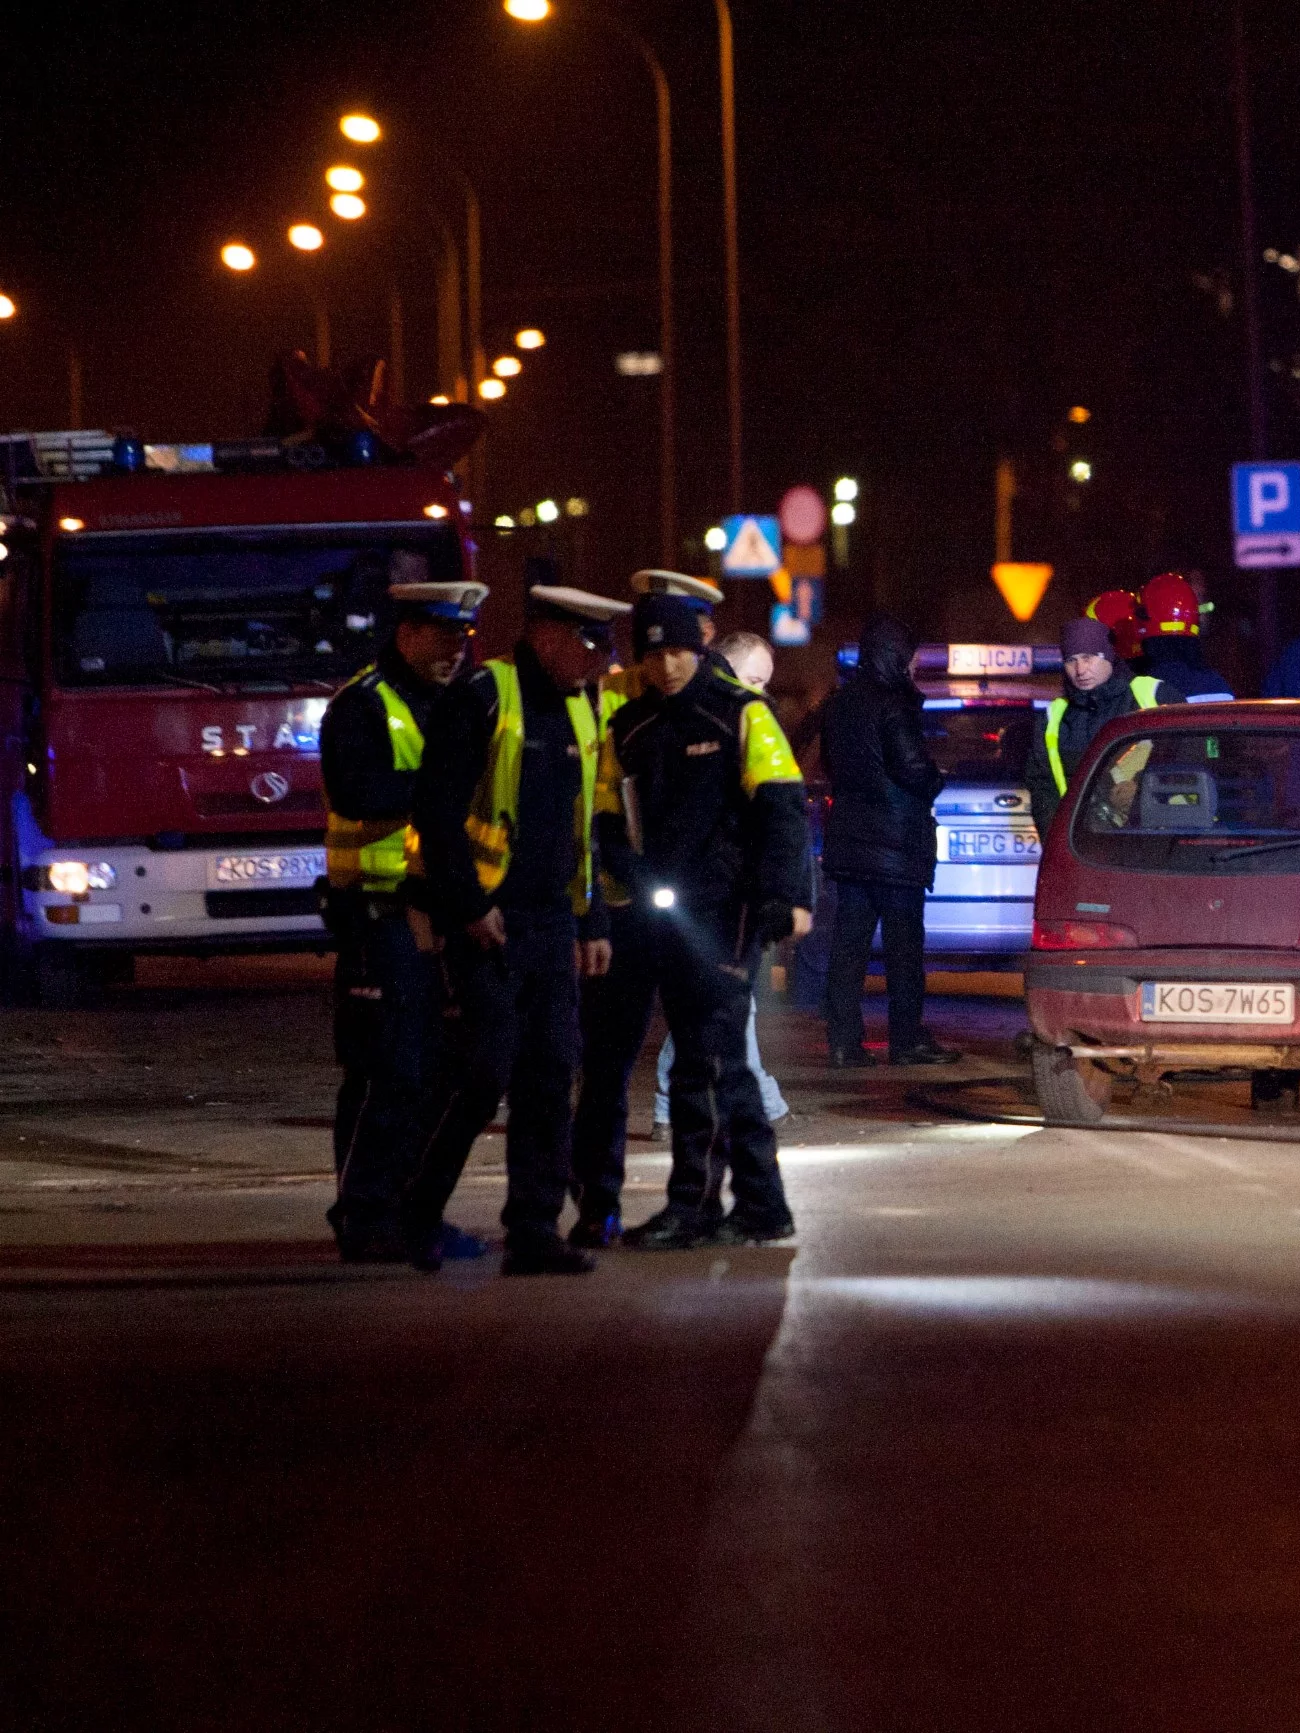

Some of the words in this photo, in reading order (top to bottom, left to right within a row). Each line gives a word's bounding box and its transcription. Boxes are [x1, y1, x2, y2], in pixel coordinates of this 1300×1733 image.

[1249, 471, 1289, 528] P
[1158, 987, 1214, 1013] KOS
[1224, 988, 1287, 1015] 7W65
